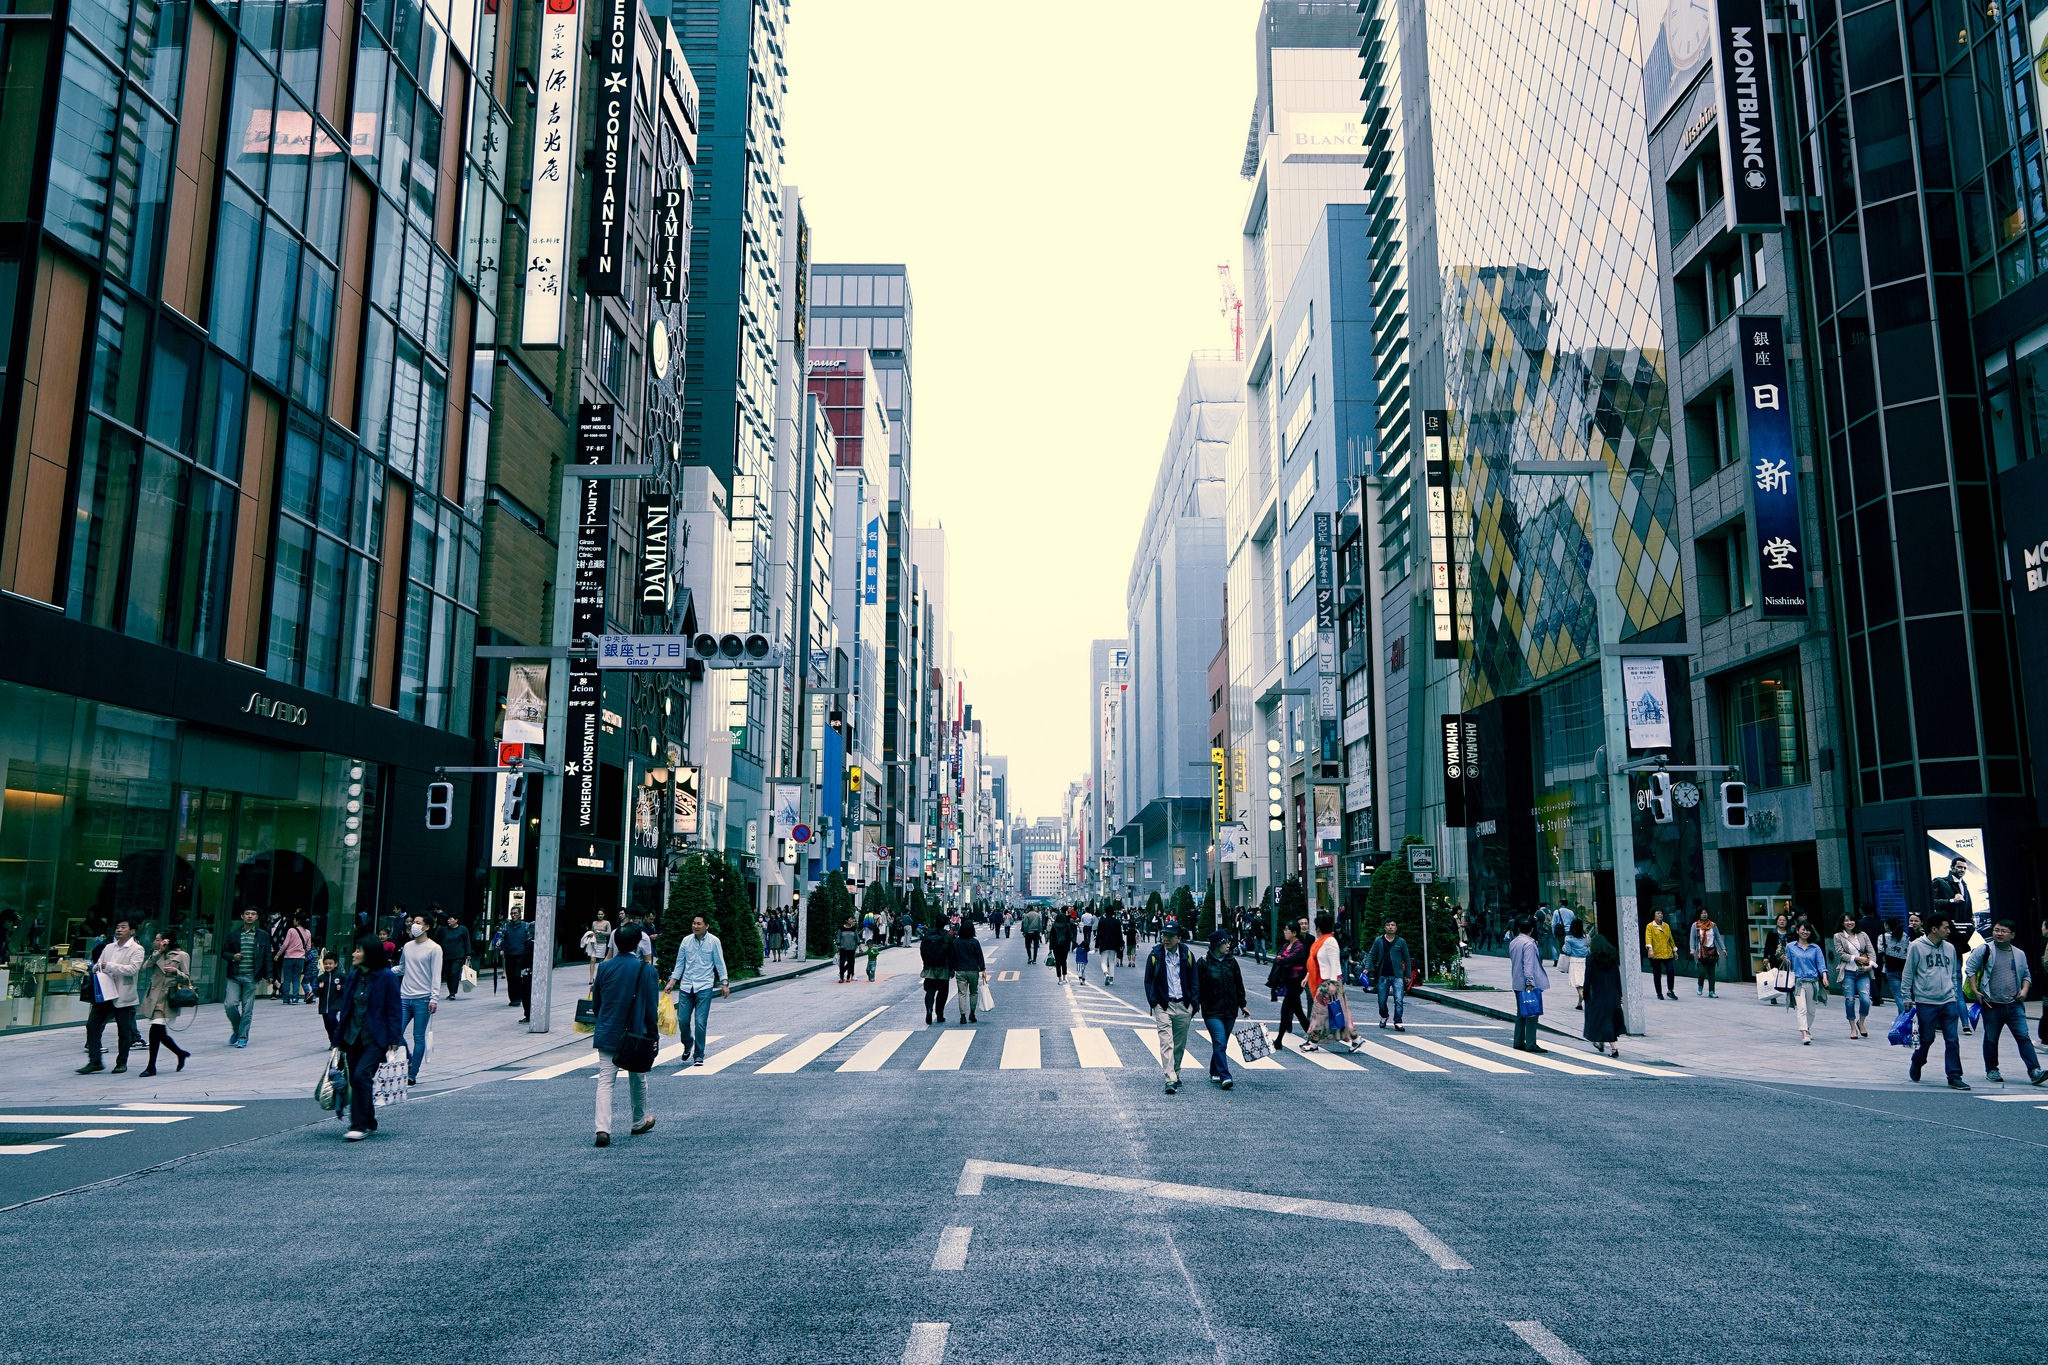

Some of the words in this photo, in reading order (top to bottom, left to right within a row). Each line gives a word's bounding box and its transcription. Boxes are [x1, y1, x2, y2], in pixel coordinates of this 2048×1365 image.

[1731, 26, 1764, 169] MONTBLANC
[1296, 132, 1363, 145] BLANC
[599, 100, 622, 273] CONSTANTIN
[664, 191, 680, 297] DAMIANI
[1753, 331, 1771, 366] 銀座
[1753, 383, 1797, 570] 日新堂
[643, 505, 669, 603] DAMIANI
[867, 530, 878, 595] 名鉄観光
[1318, 590, 1333, 628] ダンス
[1765, 596, 1805, 606] Nisshindo
[604, 643, 680, 657] 銀座七丁目
[627, 657, 649, 666] Ginza
[651, 657, 657, 665] 7
[1321, 654, 1332, 671] Dr.
[241, 692, 308, 726] SHISEIDO
[582, 713, 595, 772] CONSTANTIN
[1445, 722, 1459, 765] YAMAHA
[580, 774, 593, 827] VACHERON
[1238, 809, 1249, 859] ZARA
[634, 856, 659, 877] DAMIANI
[1925, 953, 1950, 969] GAP
